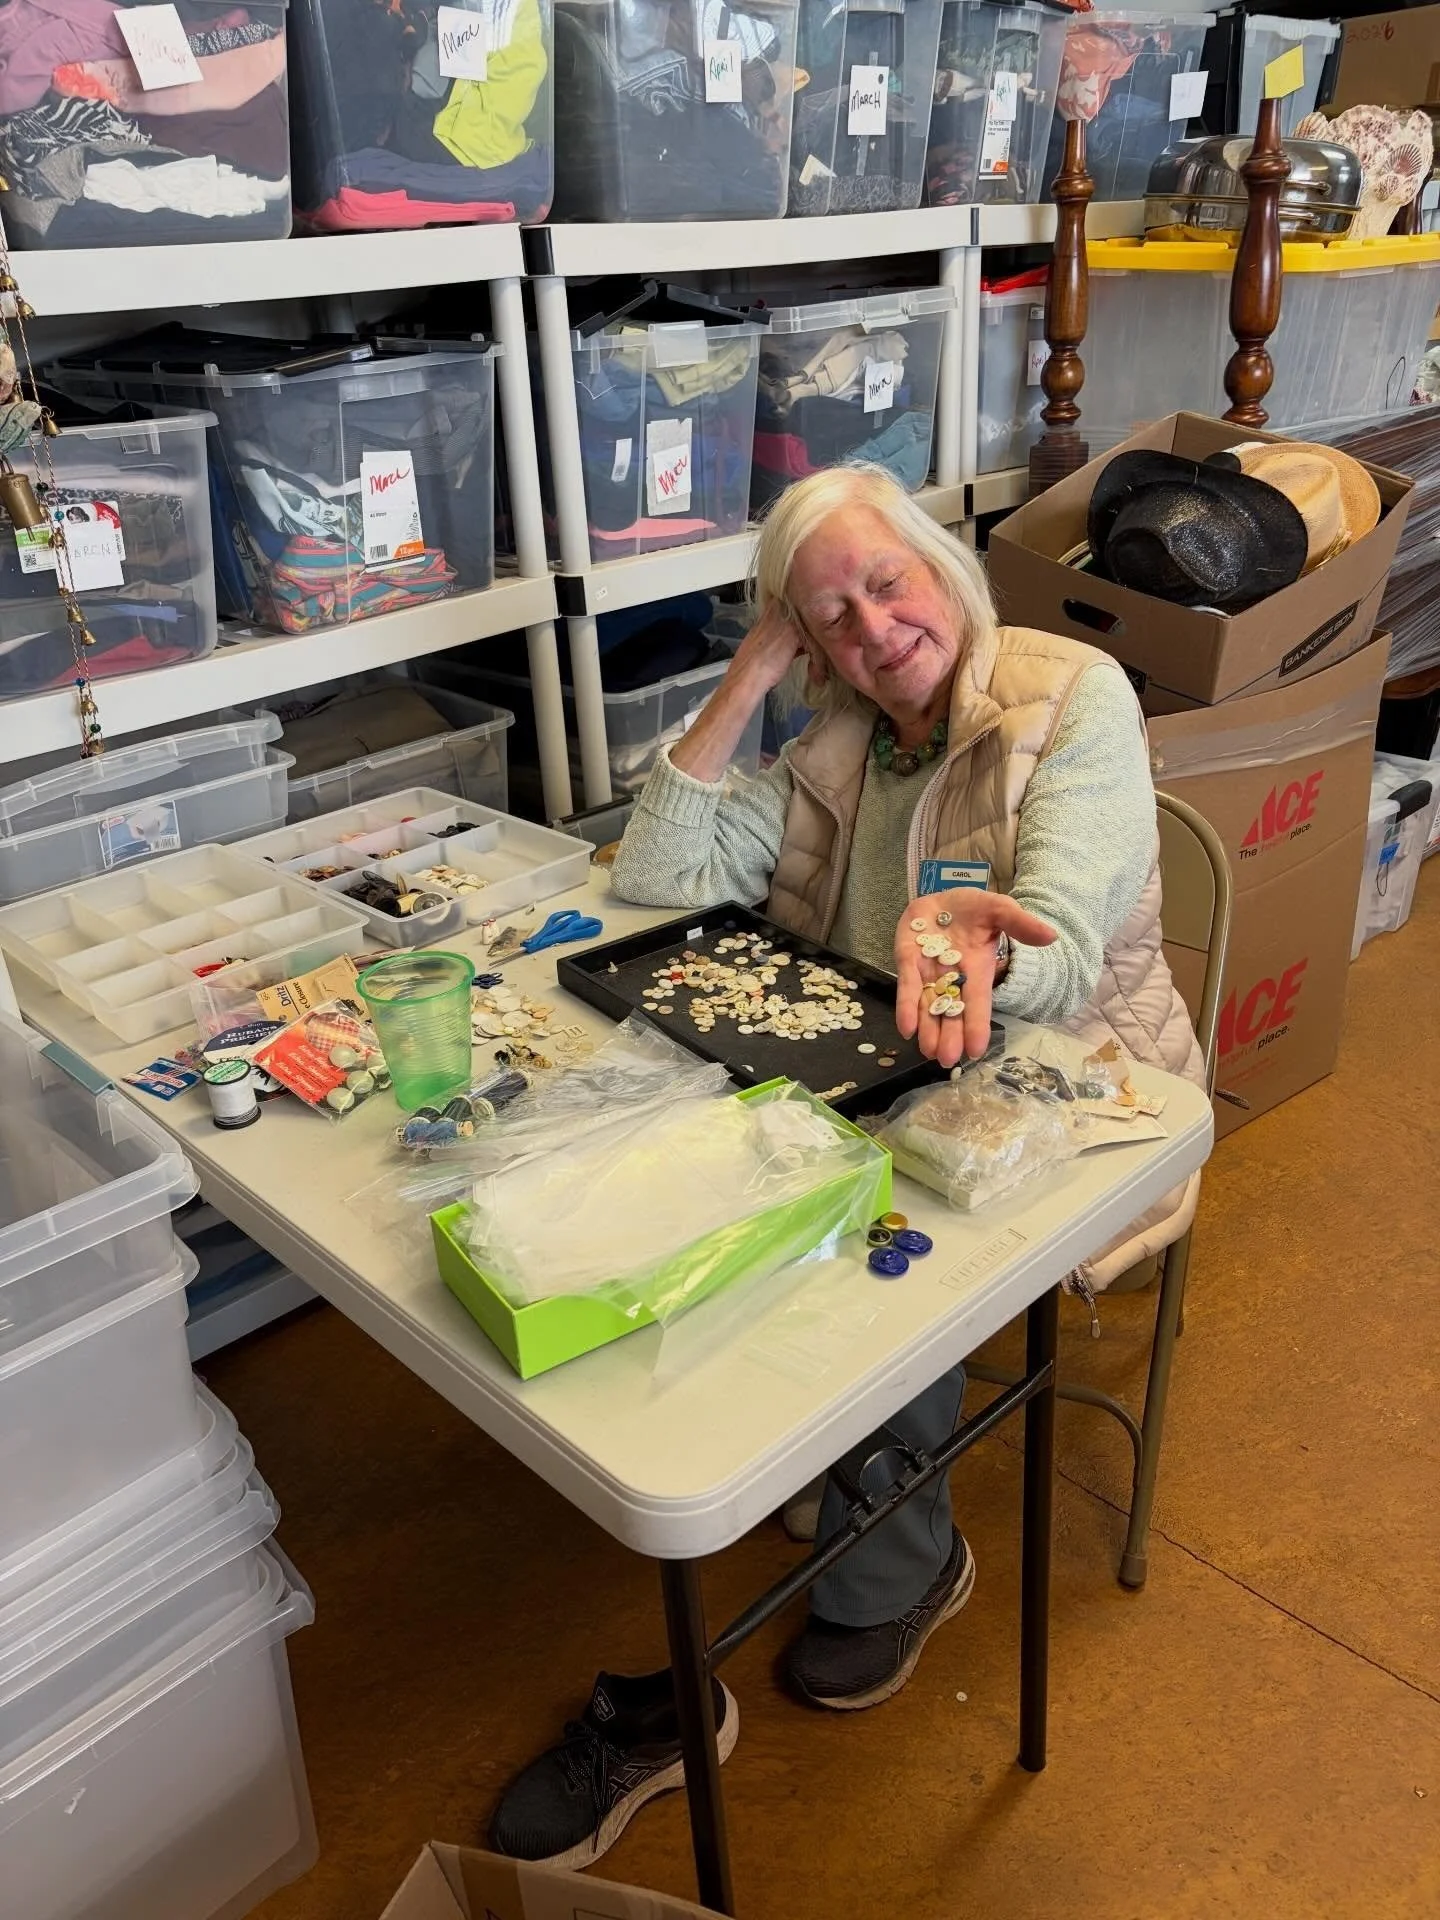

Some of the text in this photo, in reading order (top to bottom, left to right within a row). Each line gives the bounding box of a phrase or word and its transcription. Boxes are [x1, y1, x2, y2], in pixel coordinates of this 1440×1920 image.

[1284, 607, 1354, 668] BANKERS BOX
[1240, 769, 1325, 848] ACE
[1239, 848, 1258, 860] The
[276, 985, 291, 1006] Dritz
[1217, 956, 1309, 1058] ACE
[226, 1025, 278, 1038] RUBANS
